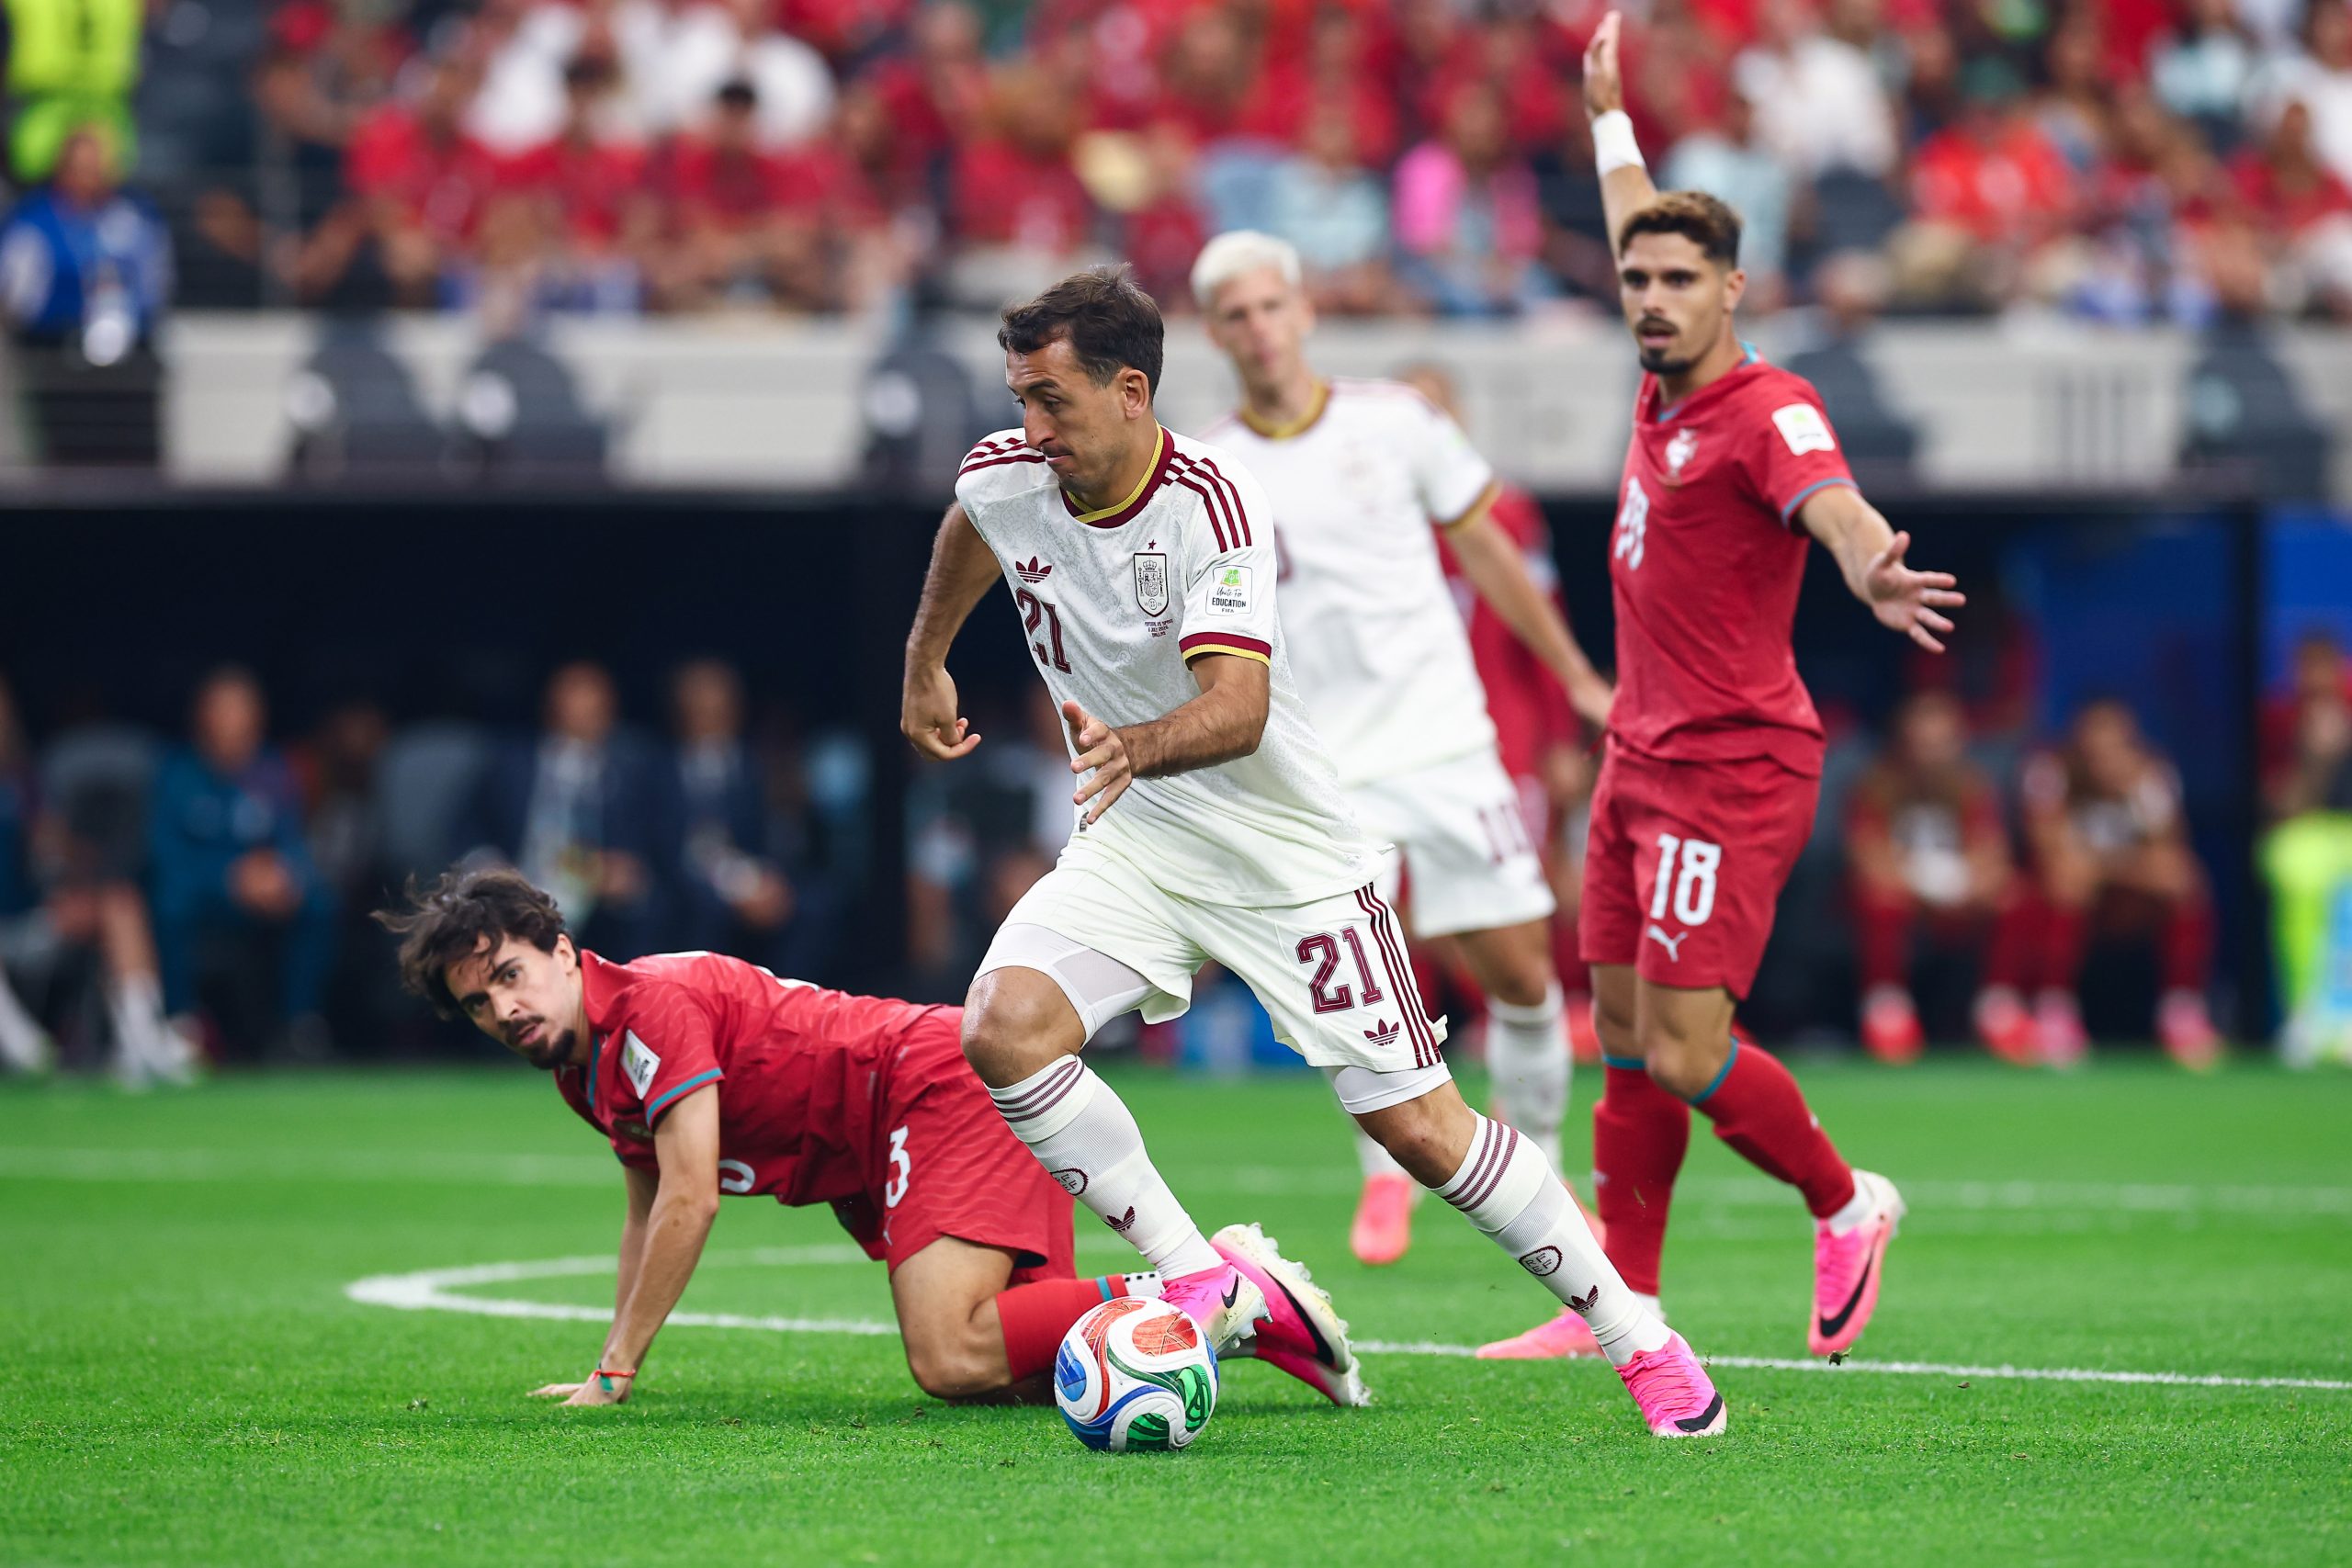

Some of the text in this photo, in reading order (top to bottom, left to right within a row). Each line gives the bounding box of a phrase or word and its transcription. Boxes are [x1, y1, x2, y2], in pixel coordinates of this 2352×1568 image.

[1211, 597, 1247, 608] EDUCATION
[1649, 832, 1722, 927] 18
[1295, 925, 1385, 1015] 21
